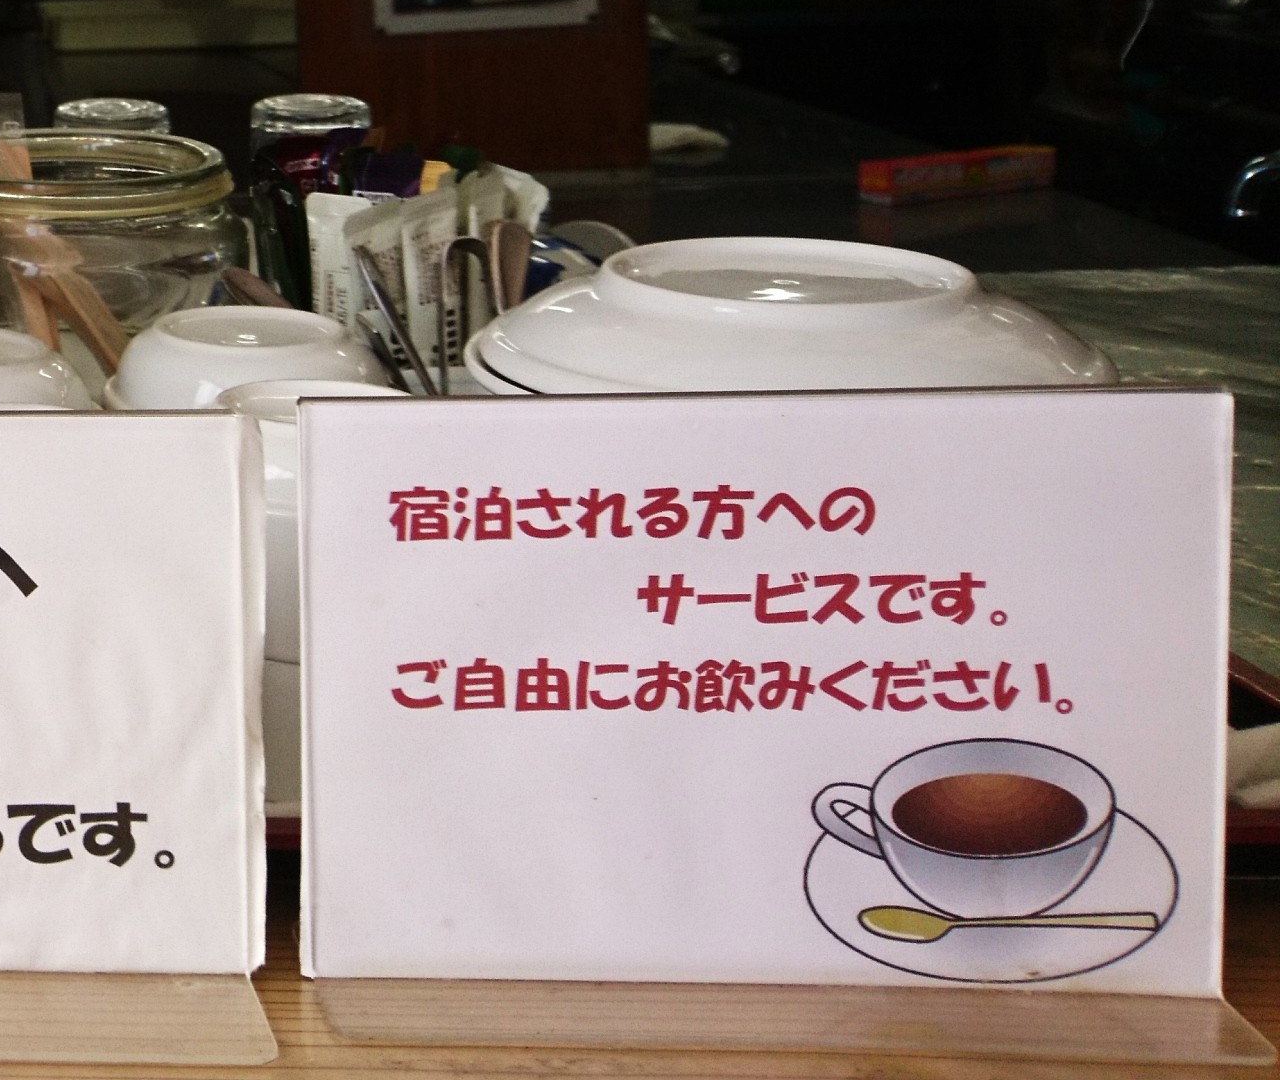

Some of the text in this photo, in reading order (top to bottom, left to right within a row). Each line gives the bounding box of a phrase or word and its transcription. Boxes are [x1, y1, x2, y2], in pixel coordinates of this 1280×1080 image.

[389, 485, 876, 541] 宿泊される方への
[636, 572, 1008, 626] サービスです。
[391, 658, 1074, 714] ご自由にお飲みください。
